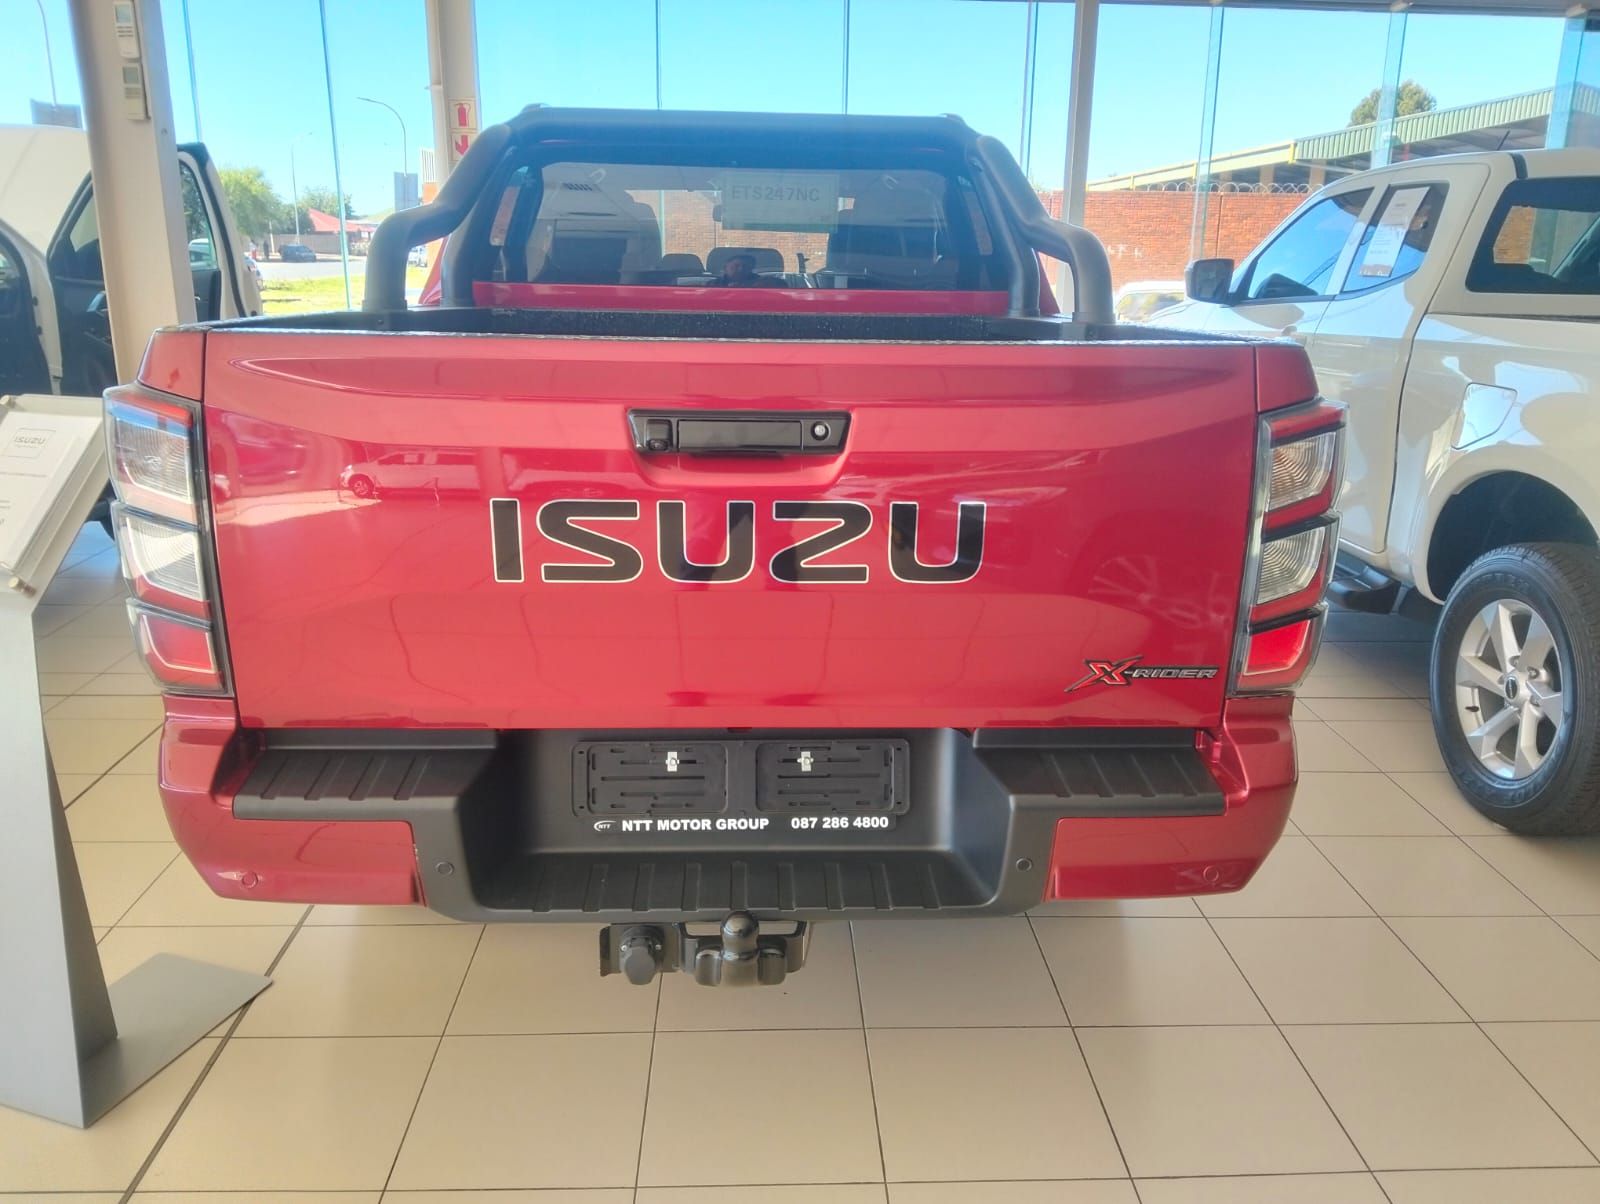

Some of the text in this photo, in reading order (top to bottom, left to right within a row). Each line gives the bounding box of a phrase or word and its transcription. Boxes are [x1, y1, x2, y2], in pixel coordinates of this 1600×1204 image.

[14, 436, 46, 445] ISUZU
[490, 498, 987, 583] ISUZU
[1064, 654, 1219, 693] X-RIDER
[621, 816, 889, 832] NTT MOTOR GROUP 087 286 4800
